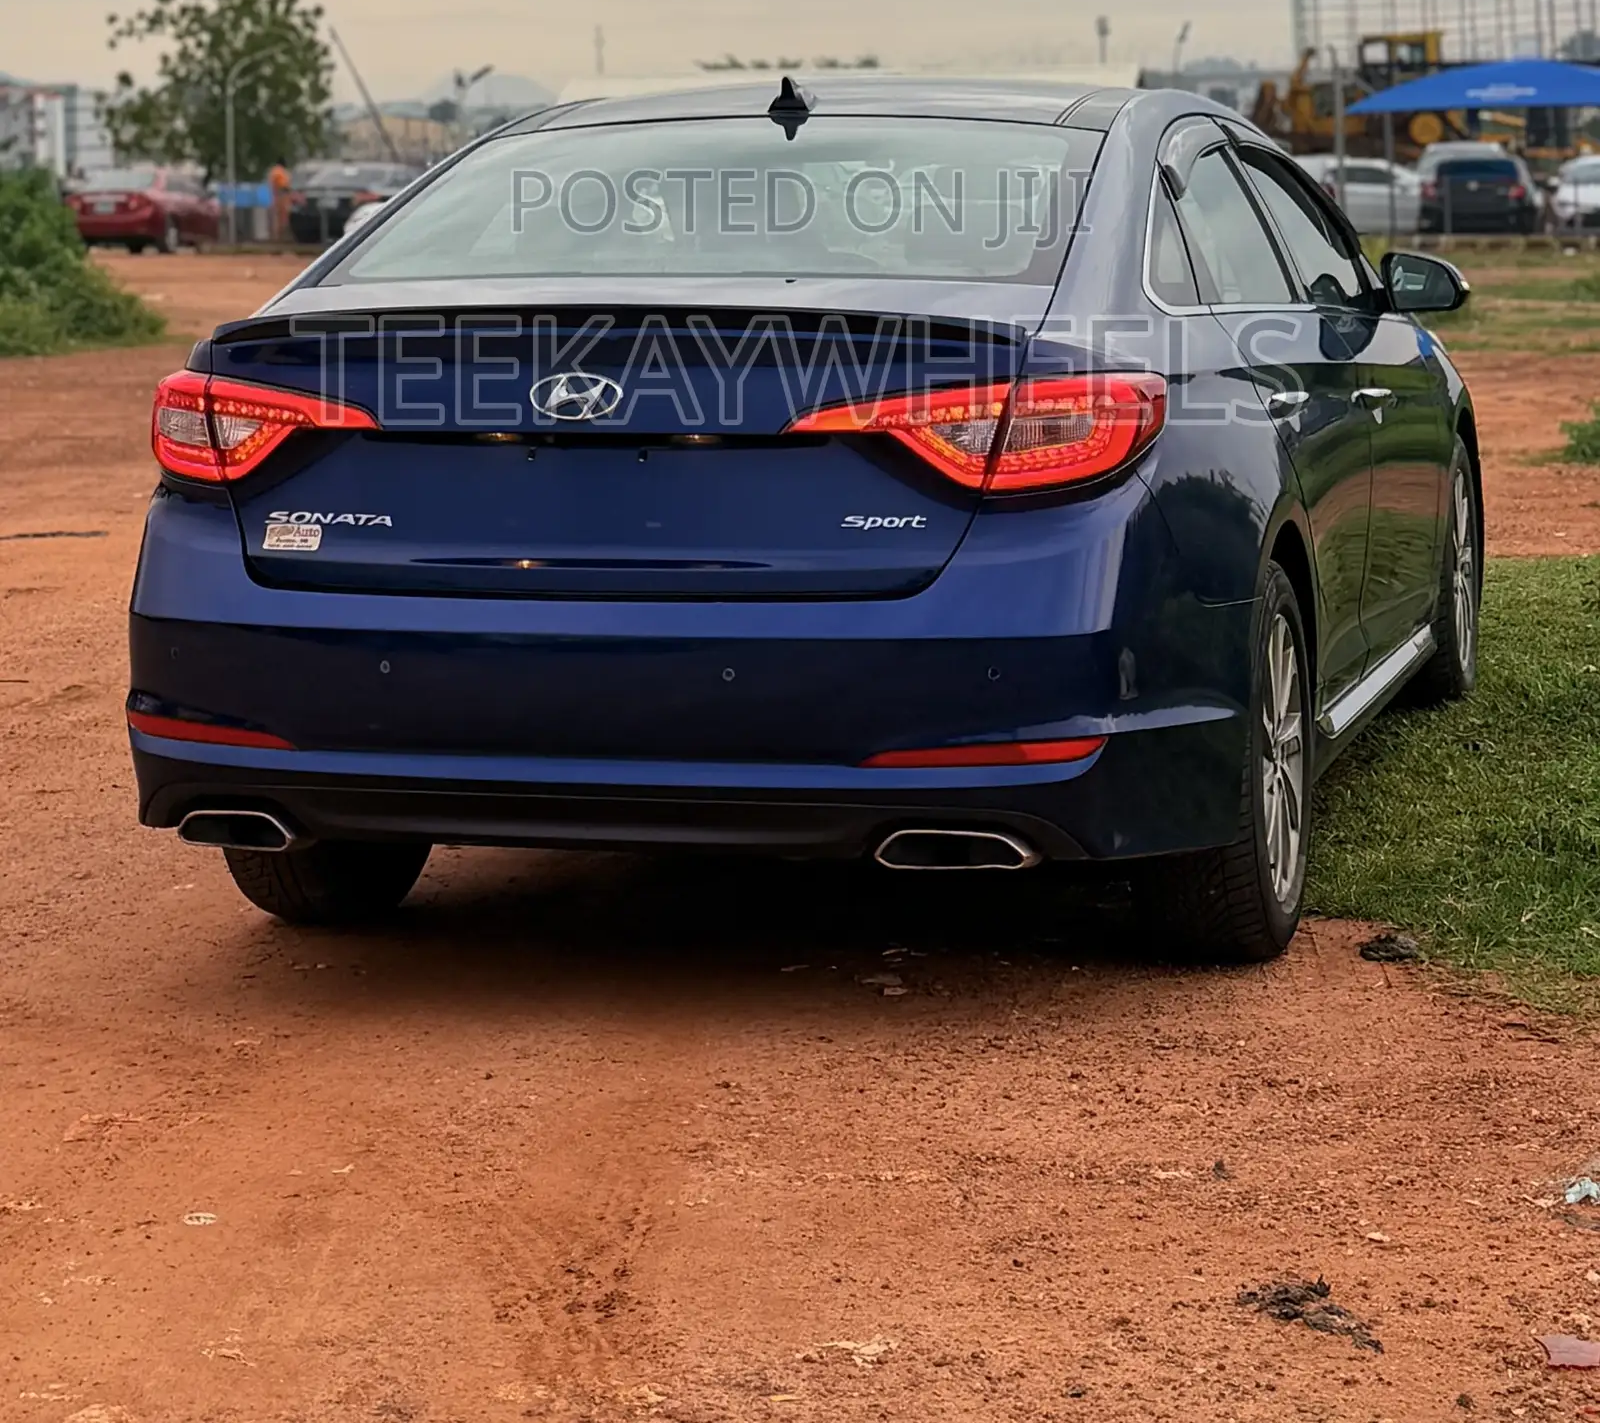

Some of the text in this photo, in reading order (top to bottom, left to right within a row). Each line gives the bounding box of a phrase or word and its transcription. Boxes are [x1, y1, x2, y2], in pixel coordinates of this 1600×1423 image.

[264, 511, 393, 527] SONATA
[841, 515, 927, 530] Sport
[293, 527, 320, 538] Auto
